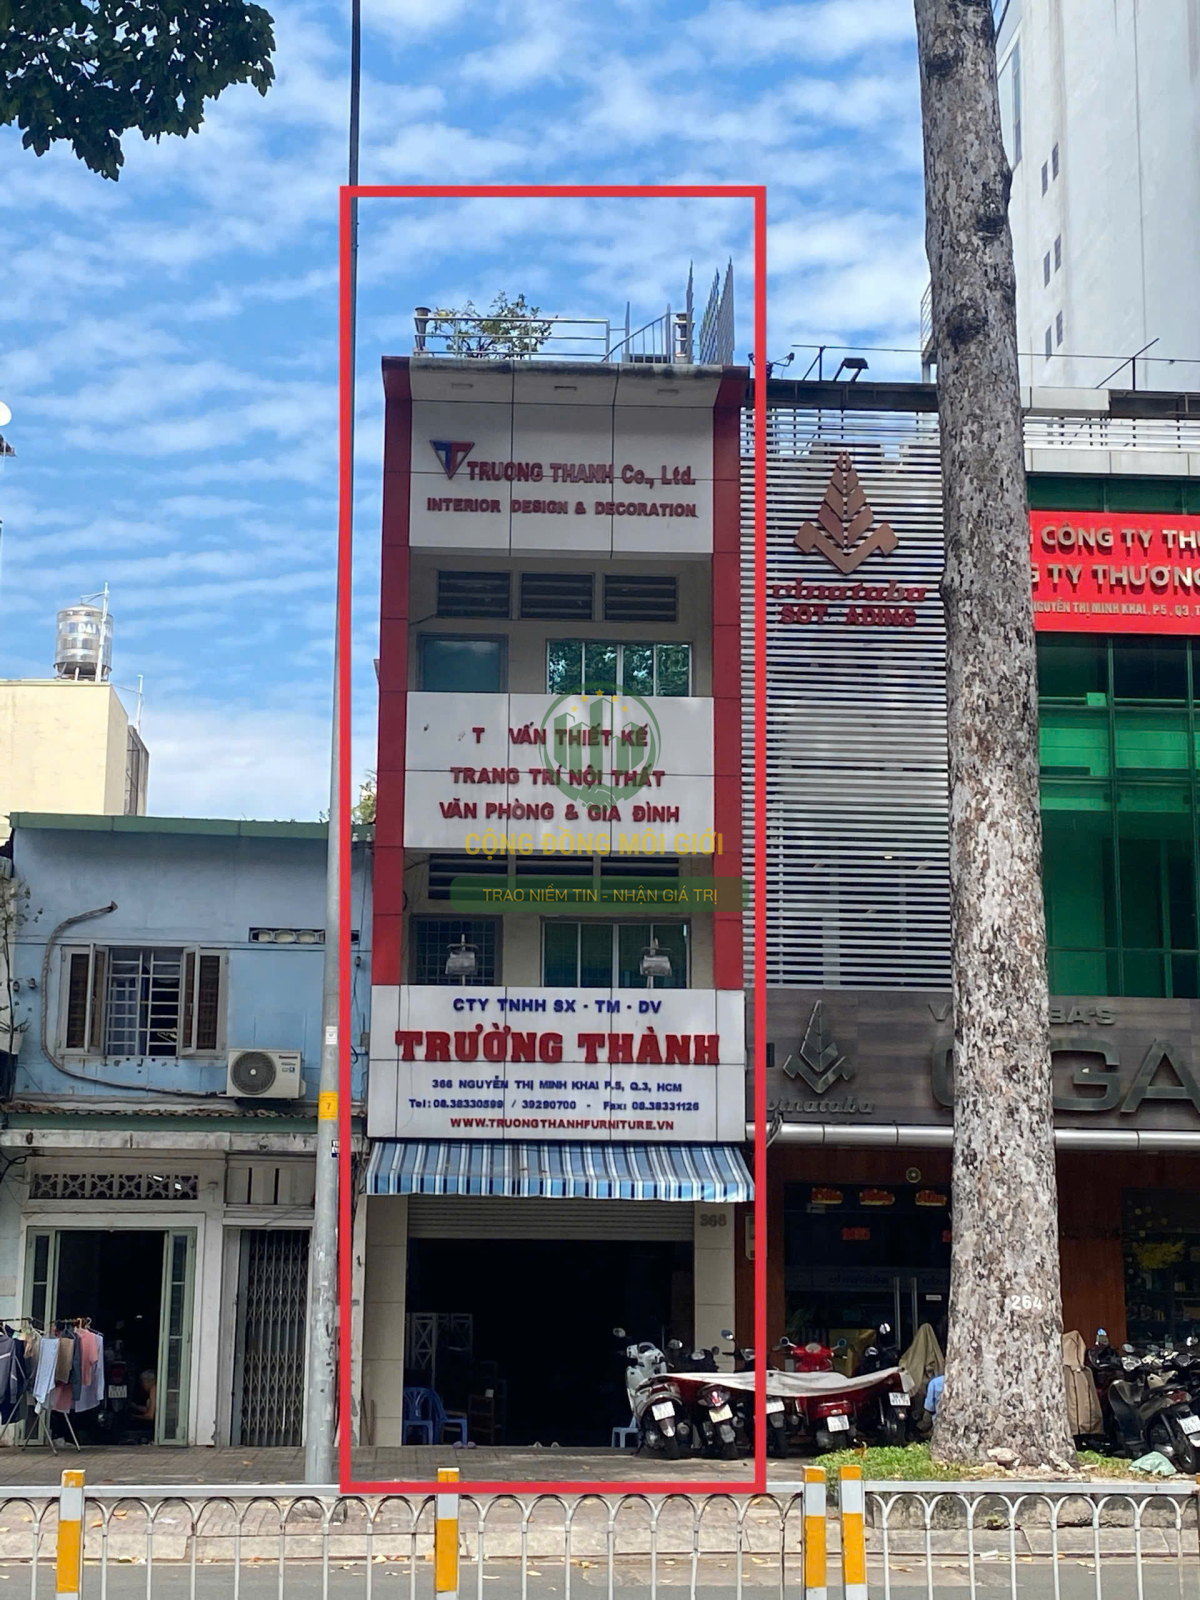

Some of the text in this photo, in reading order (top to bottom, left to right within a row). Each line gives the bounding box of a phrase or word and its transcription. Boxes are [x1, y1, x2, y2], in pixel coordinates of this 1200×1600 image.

[467, 461, 543, 483] TRUONG
[550, 463, 614, 484] THANH
[661, 465, 696, 486] Ltd.
[427, 497, 699, 518] INTERIOR DESIGN & DECORATION
[1041, 523, 1200, 549] CÔNG TY TH
[1047, 563, 1082, 585] TY
[508, 721, 546, 746] VẤN
[555, 723, 612, 747] THIẾT
[621, 723, 649, 747] KẾ
[450, 763, 666, 788] TRANG TRÍ NỘI THẤT
[439, 798, 679, 823] VĂN PHÒNG & GIA ĐÌNH
[453, 998, 489, 1012] CTY
[497, 998, 546, 1013] TNHH
[554, 999, 576, 1013] SX
[595, 1000, 621, 1014] TM
[639, 1000, 662, 1014] DV
[395, 1023, 720, 1065] TRƯỜNG THÀNH
[458, 1075, 508, 1090] NGUYỄN
[515, 1080, 533, 1091] THỊ
[539, 1080, 567, 1090] MINH
[572, 1081, 599, 1091] KHAI
[657, 1083, 682, 1093] HCM
[450, 1118, 674, 1130] WWW.TRUONGTHANHFURNITURE.VN
[1011, 1295, 1043, 1310] 264
